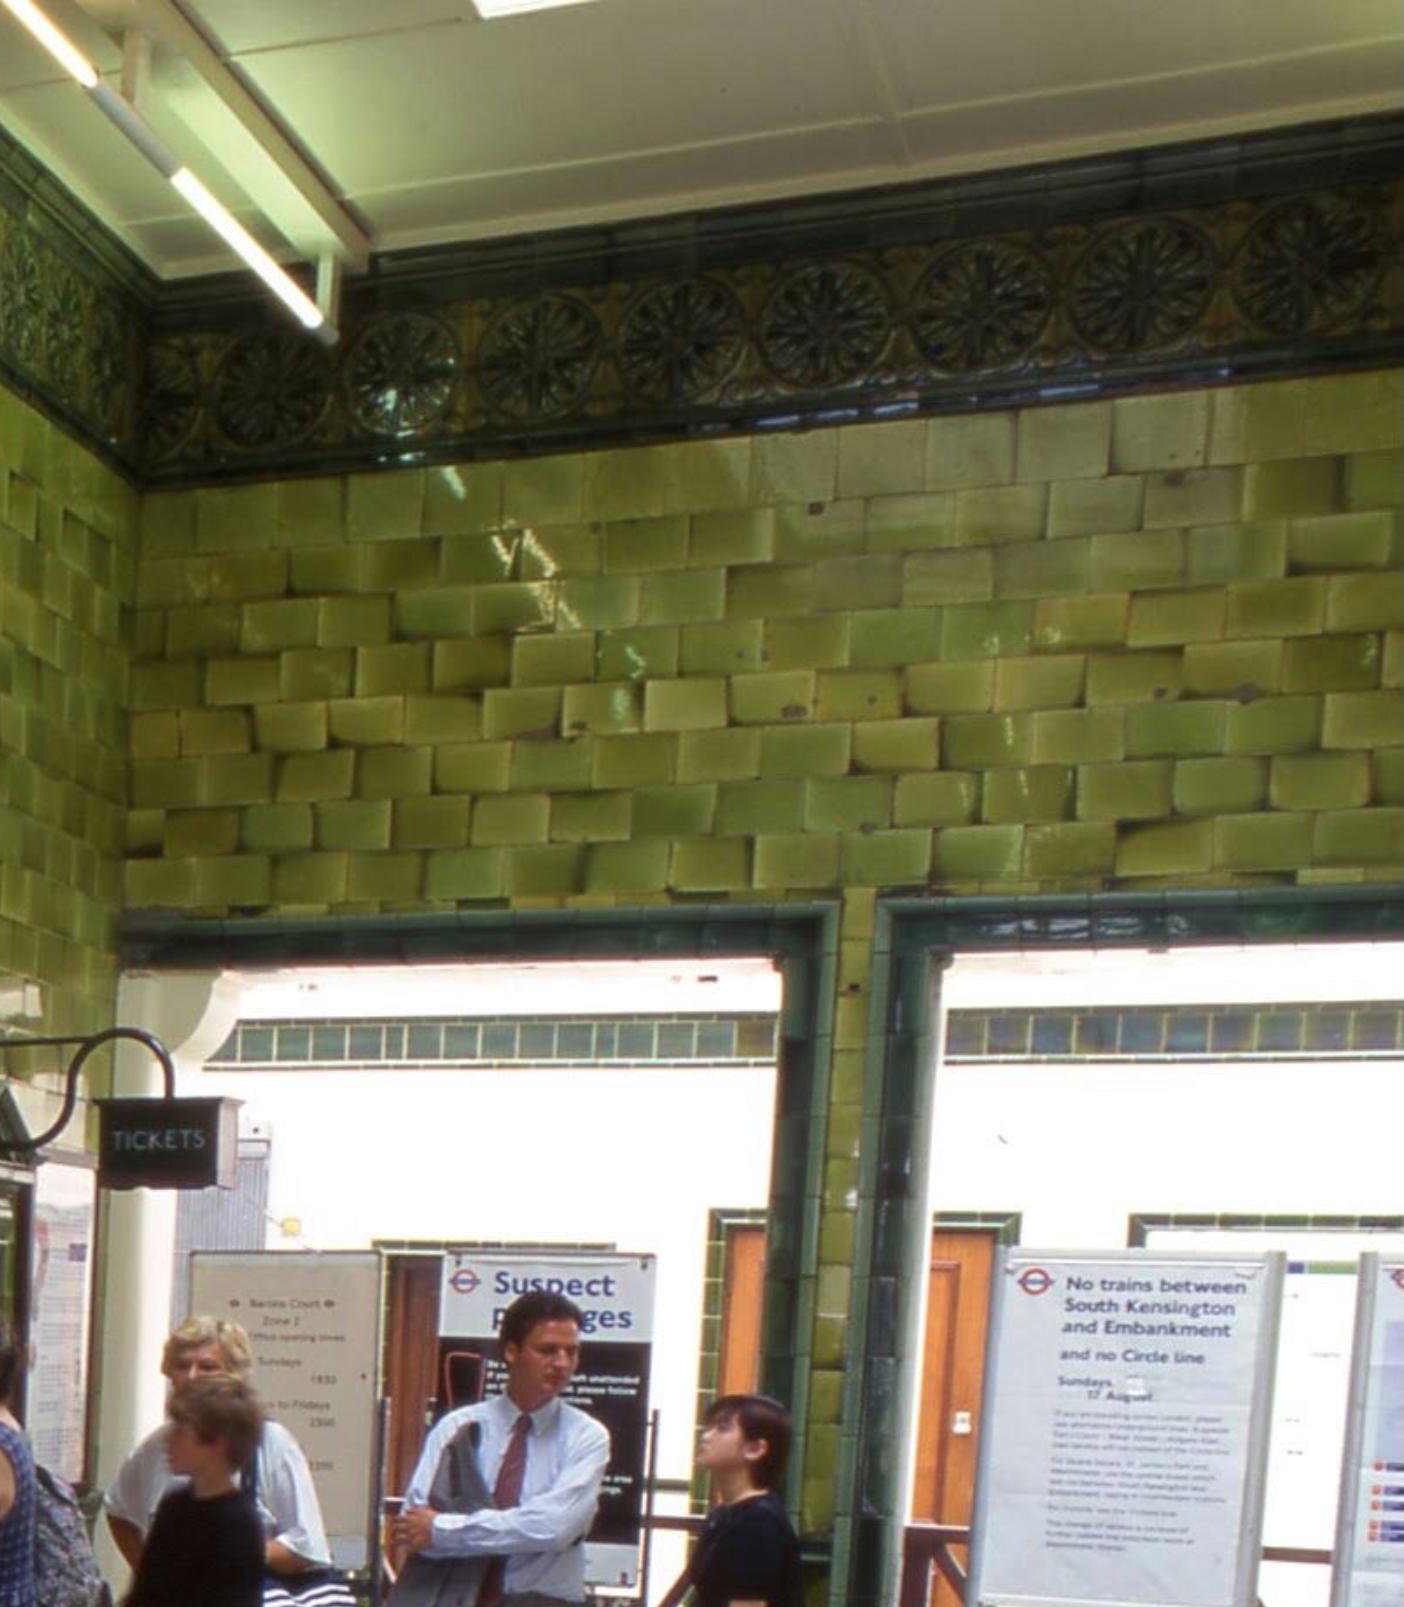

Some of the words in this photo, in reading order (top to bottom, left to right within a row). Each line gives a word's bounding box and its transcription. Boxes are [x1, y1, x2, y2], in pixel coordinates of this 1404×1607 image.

[111, 1127, 206, 1152] TICKETS
[494, 1270, 616, 1297] Suspect
[1066, 1277, 1093, 1291] No
[1100, 1277, 1153, 1292] trains
[1160, 1278, 1247, 1295] between
[1064, 1297, 1119, 1313] South
[1125, 1298, 1236, 1318] Kensington
[491, 1307, 633, 1334] pges
[1061, 1320, 1098, 1334] and
[1103, 1320, 1232, 1338] Embankment
[1059, 1348, 1091, 1361] and
[1095, 1352, 1116, 1362] no
[1121, 1349, 1170, 1363] Circle
[1173, 1351, 1206, 1365] line
[1057, 1375, 1113, 1389] Sundays
[1106, 1389, 1153, 1404] August
